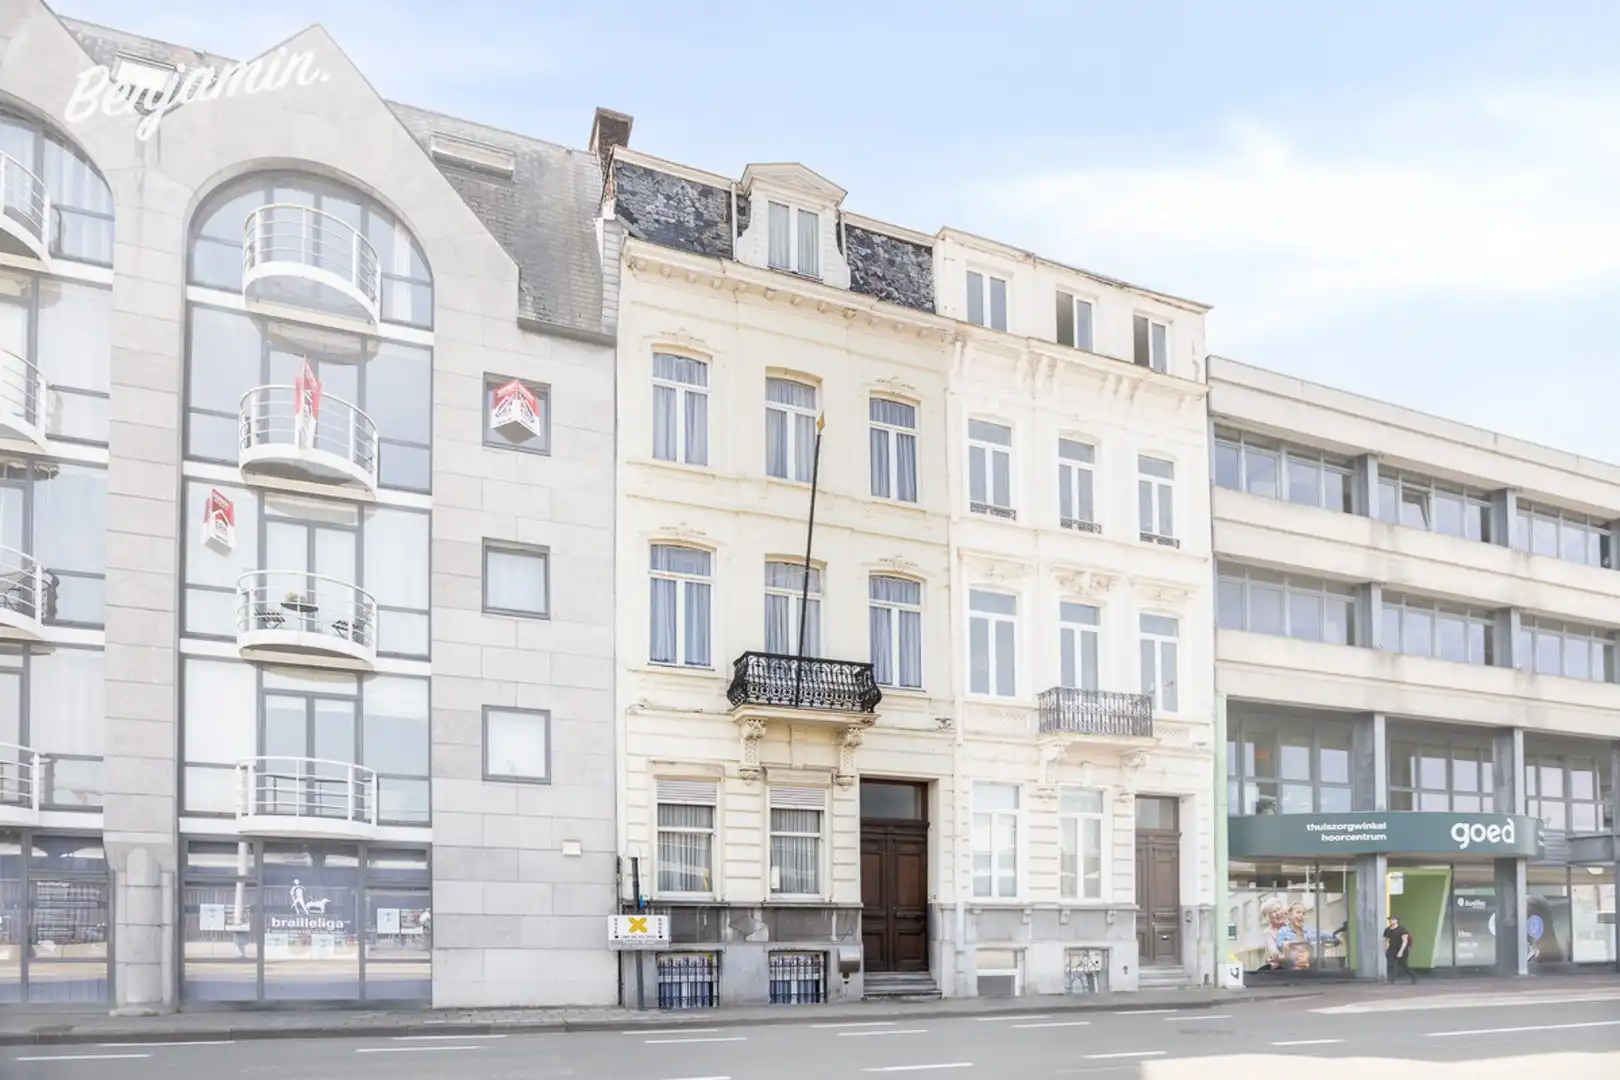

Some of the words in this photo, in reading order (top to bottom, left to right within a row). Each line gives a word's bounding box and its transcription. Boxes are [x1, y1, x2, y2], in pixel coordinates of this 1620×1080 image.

[1306, 821, 1387, 832] thuiszorgwinkel
[1321, 833, 1387, 841] hoorcentrum
[1450, 817, 1515, 850] goed
[271, 917, 344, 930] brailleliga
